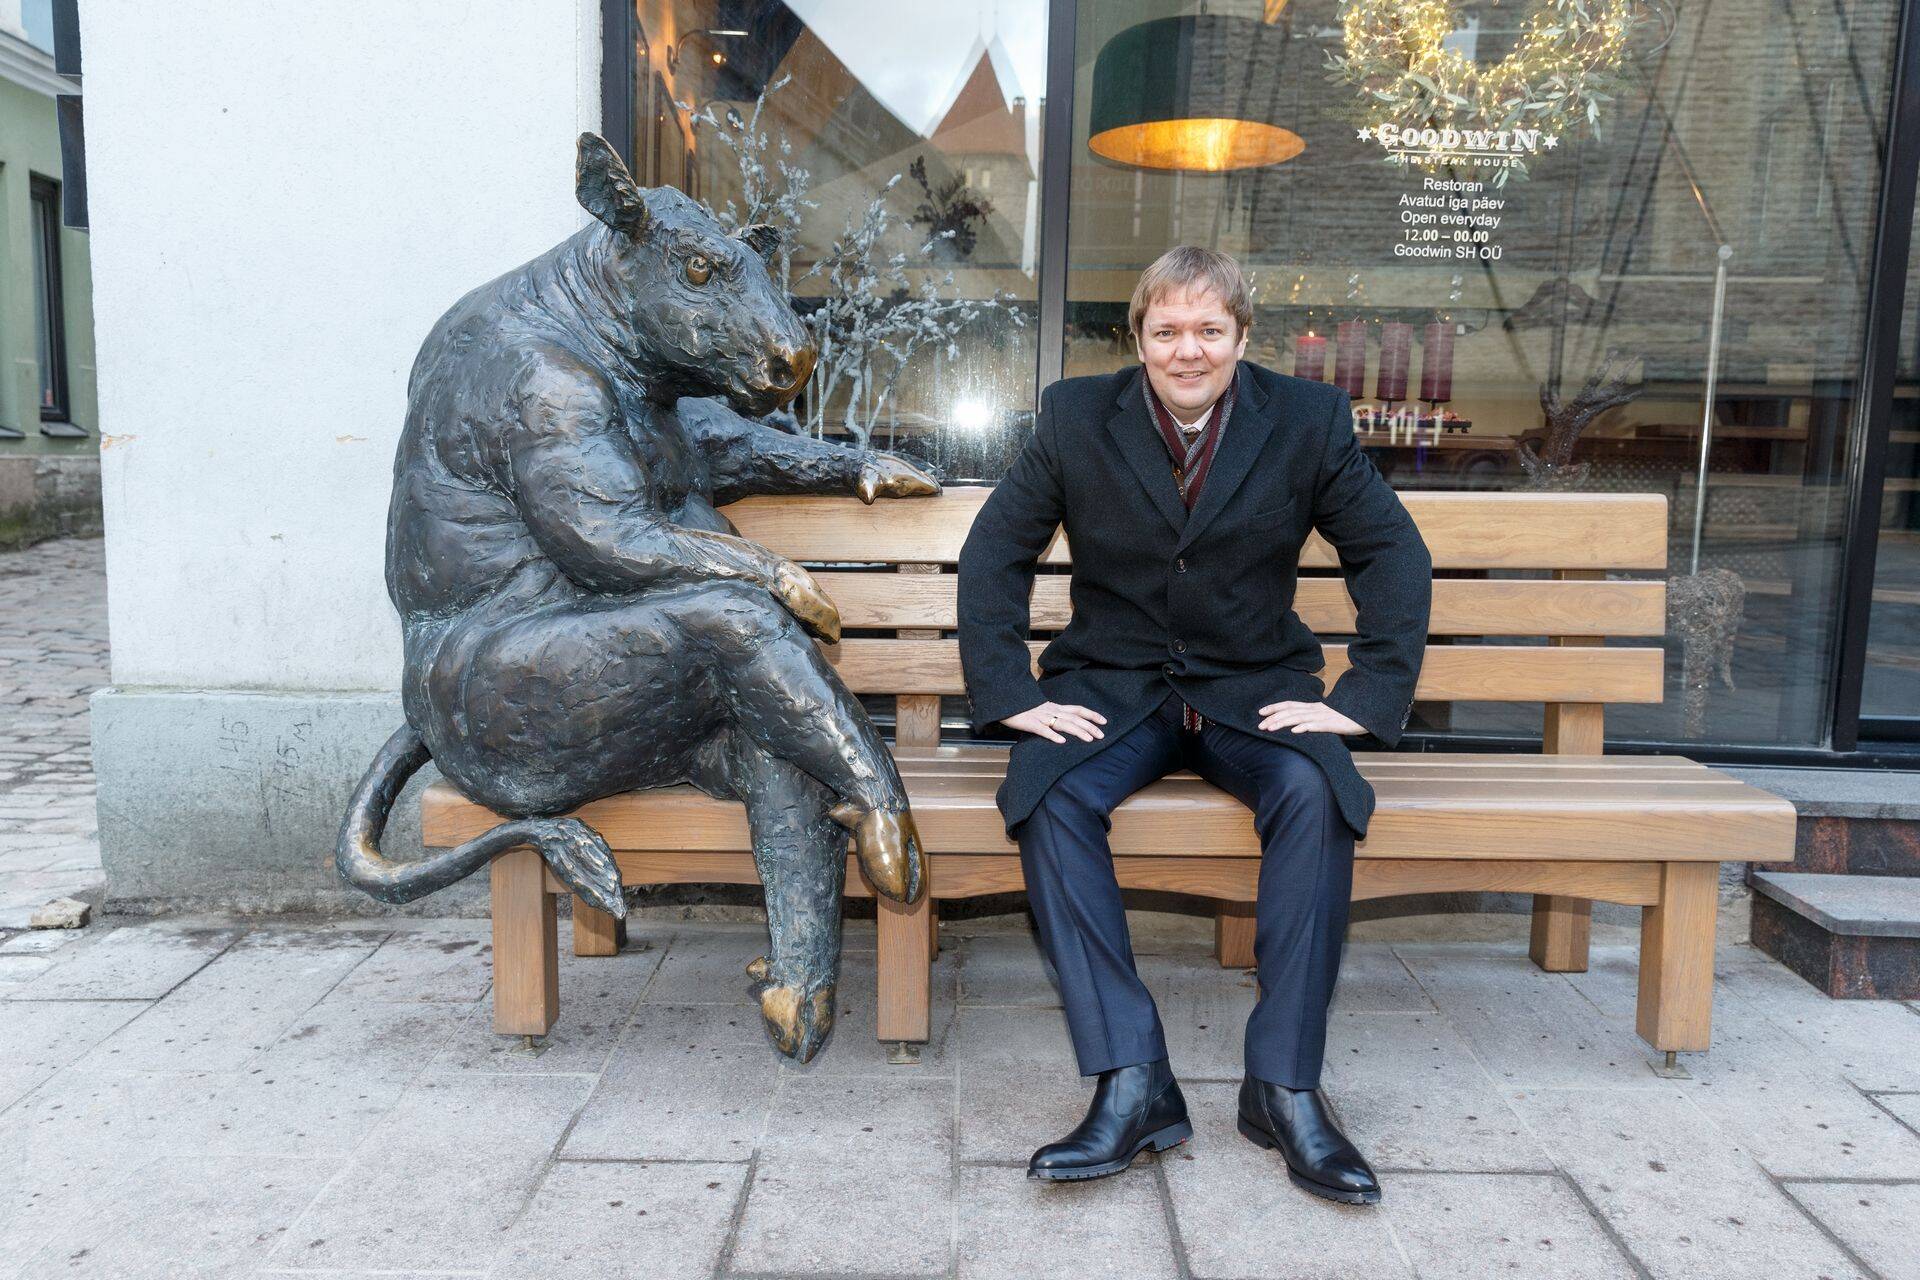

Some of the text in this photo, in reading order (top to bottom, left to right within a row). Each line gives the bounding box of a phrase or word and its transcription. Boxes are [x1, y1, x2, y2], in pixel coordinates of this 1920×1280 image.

[1377, 123, 1542, 152] GOODWIN
[1425, 156, 1467, 166] STEAK
[1473, 157, 1518, 168] HOUSE
[1423, 177, 1483, 192] Restoran
[1399, 193, 1505, 212] Avatud iga päev
[1401, 210, 1501, 229] Open everyday
[1404, 229, 1438, 241] 12.00
[1453, 230, 1489, 243] 00.00
[1394, 243, 1502, 260] Goodwin SH OÜ
